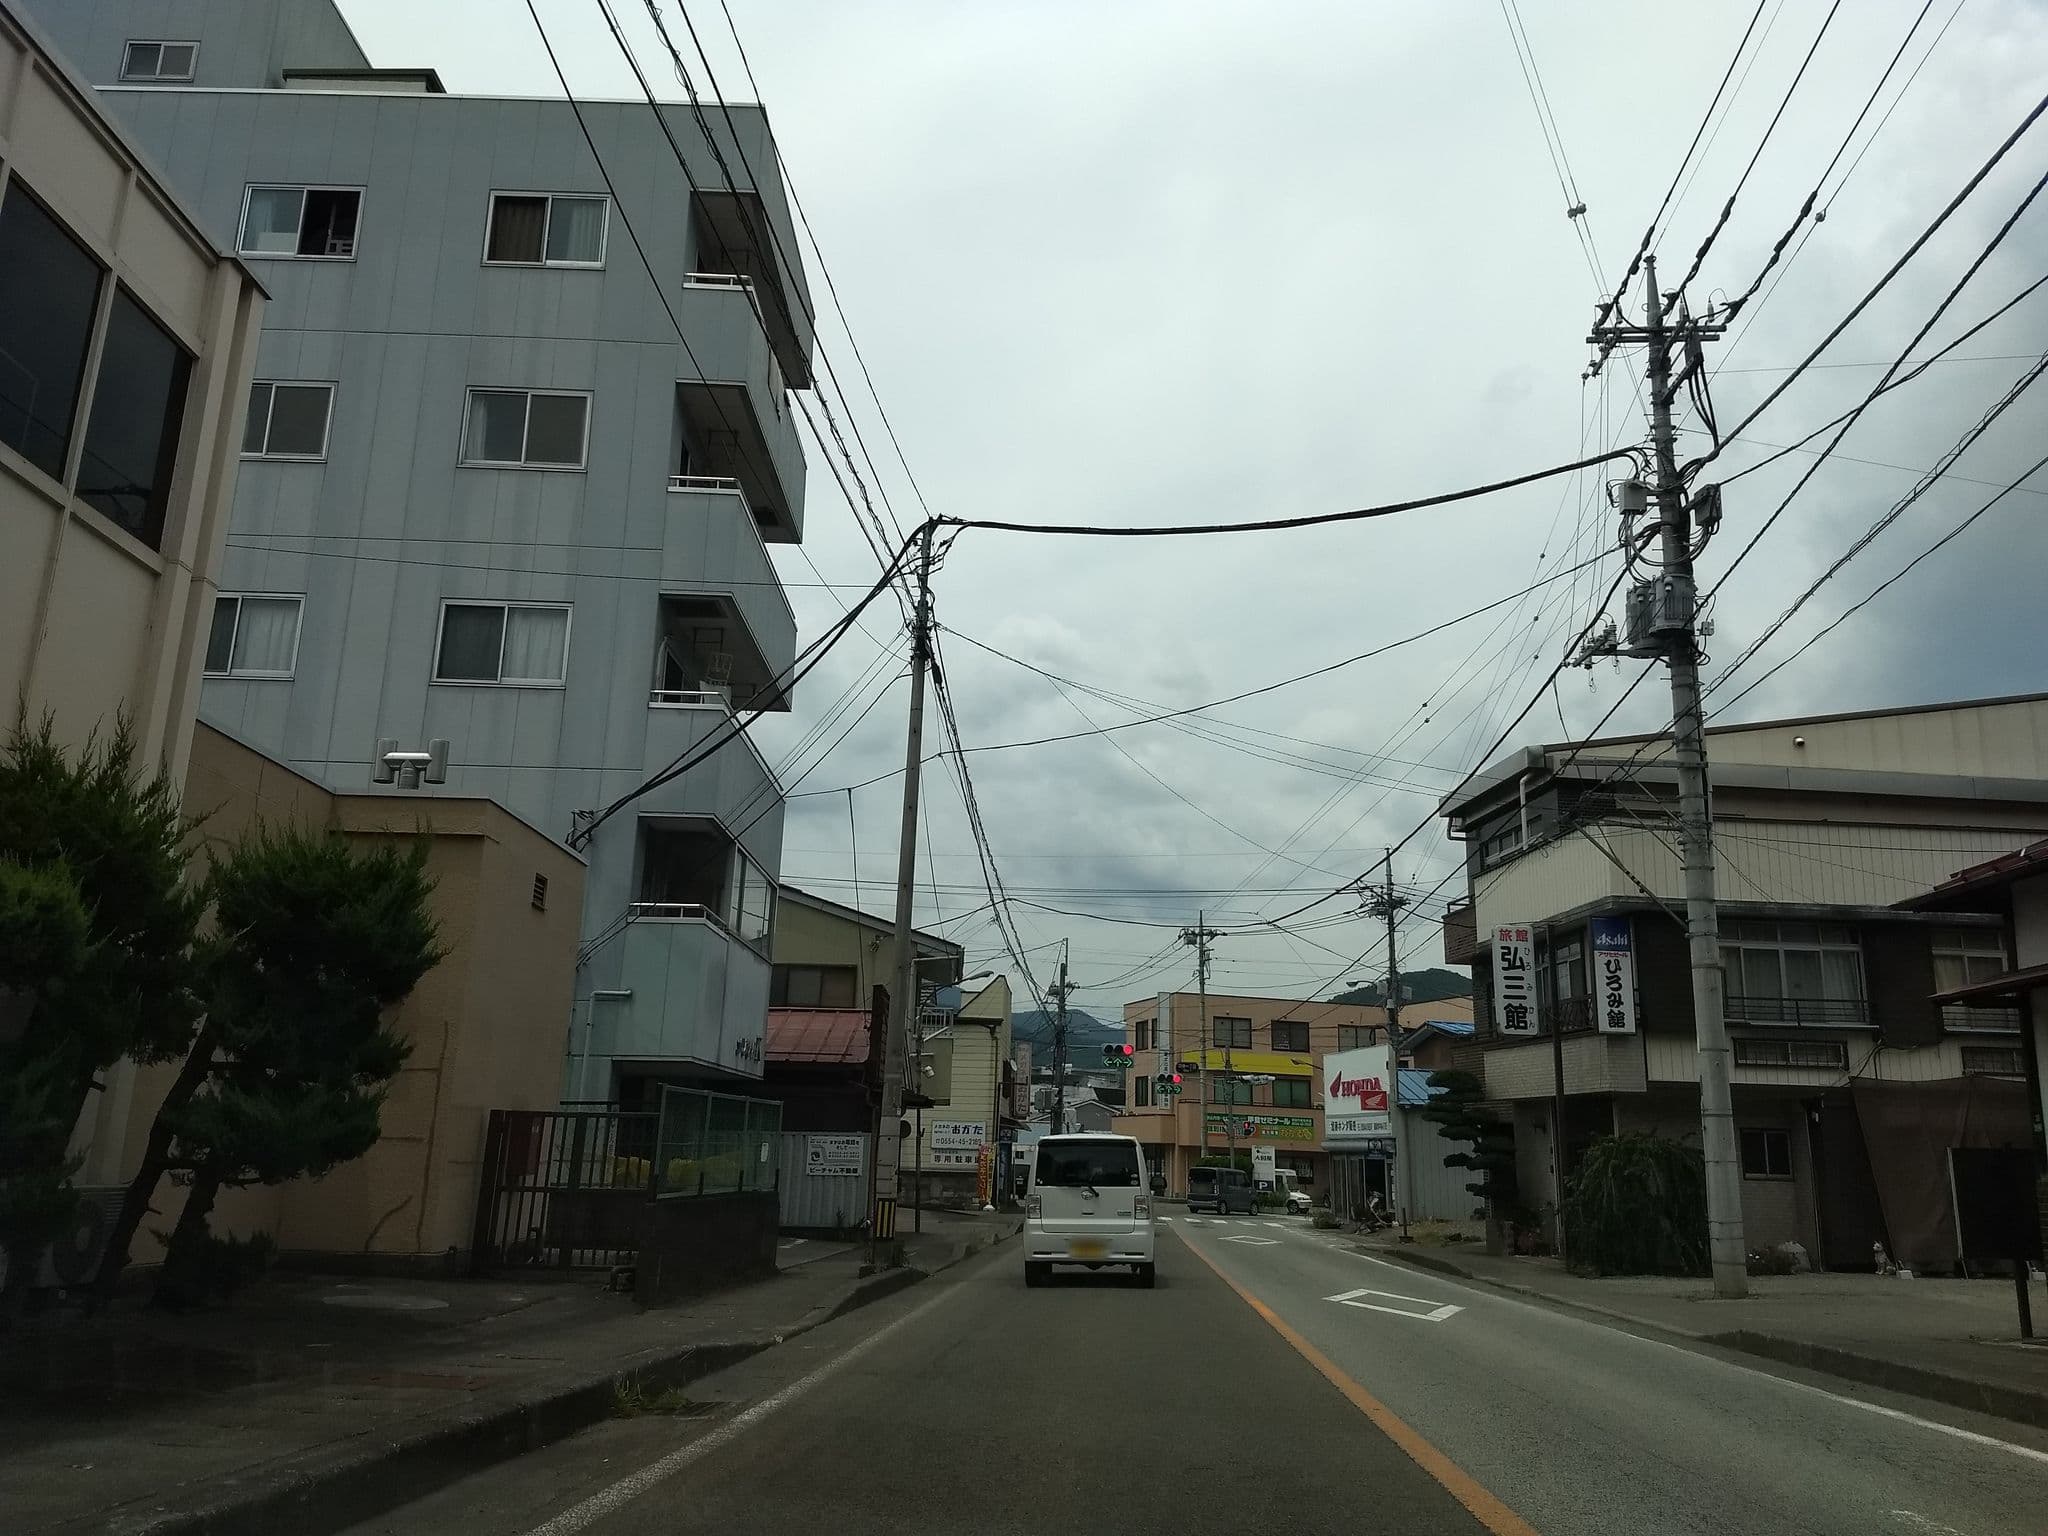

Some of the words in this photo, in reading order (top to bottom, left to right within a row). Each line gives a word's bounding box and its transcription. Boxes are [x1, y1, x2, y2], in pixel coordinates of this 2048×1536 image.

[1499, 928, 1529, 942] 旅館
[1596, 933, 1628, 946] Asahi
[1500, 946, 1529, 1030] 弘三館
[1604, 958, 1626, 1028] ひろみ館
[1341, 1077, 1383, 1097] HONDA
[951, 1124, 983, 1135] おがた
[1259, 1181, 1268, 1190] P
